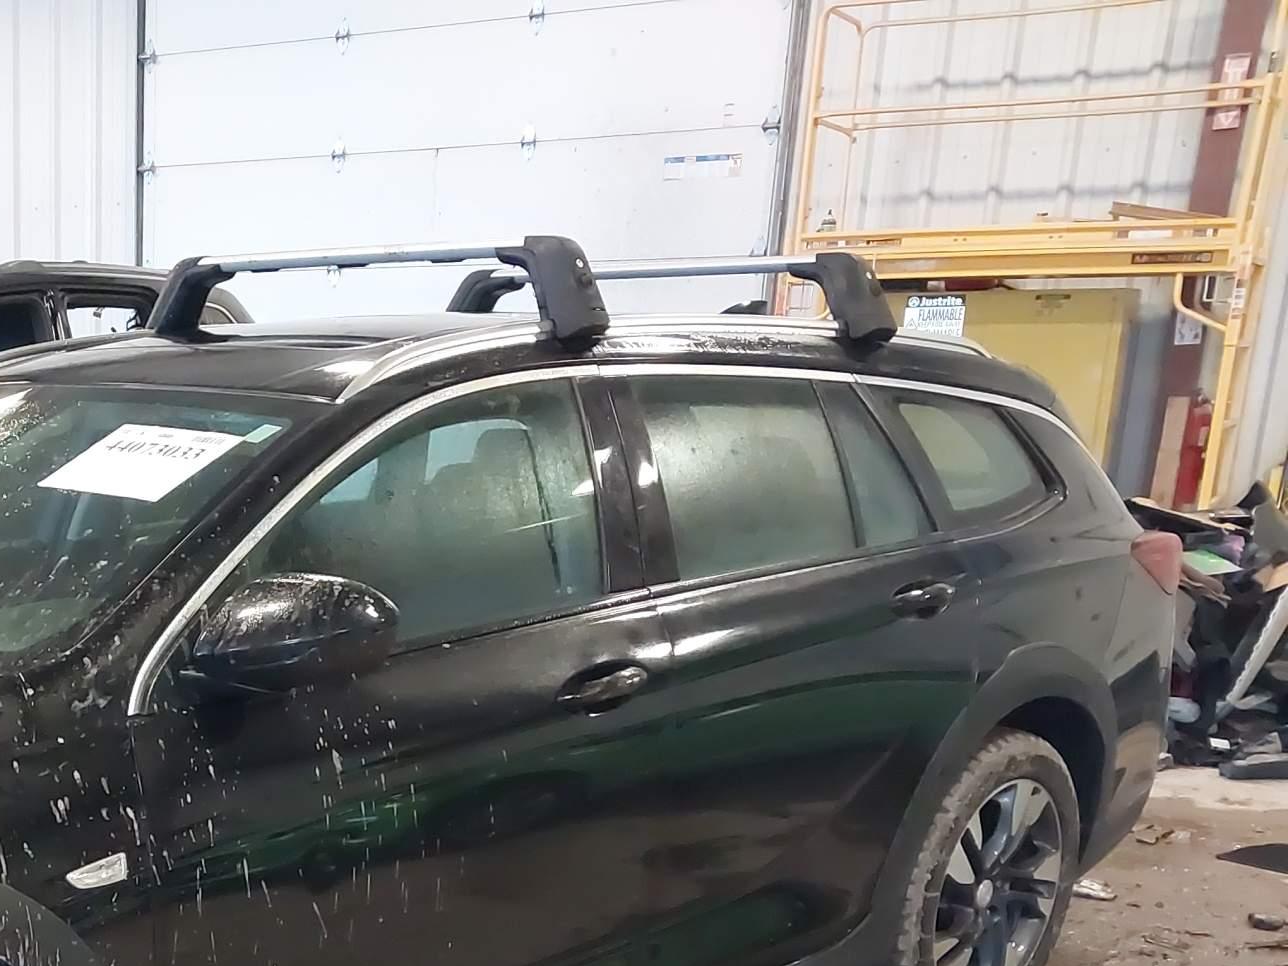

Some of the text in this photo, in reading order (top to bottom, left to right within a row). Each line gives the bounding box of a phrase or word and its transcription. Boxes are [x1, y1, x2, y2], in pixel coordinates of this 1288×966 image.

[920, 296, 963, 306] Justrite
[918, 308, 963, 321] FLAMMABLE
[105, 440, 207, 460] 44073033
